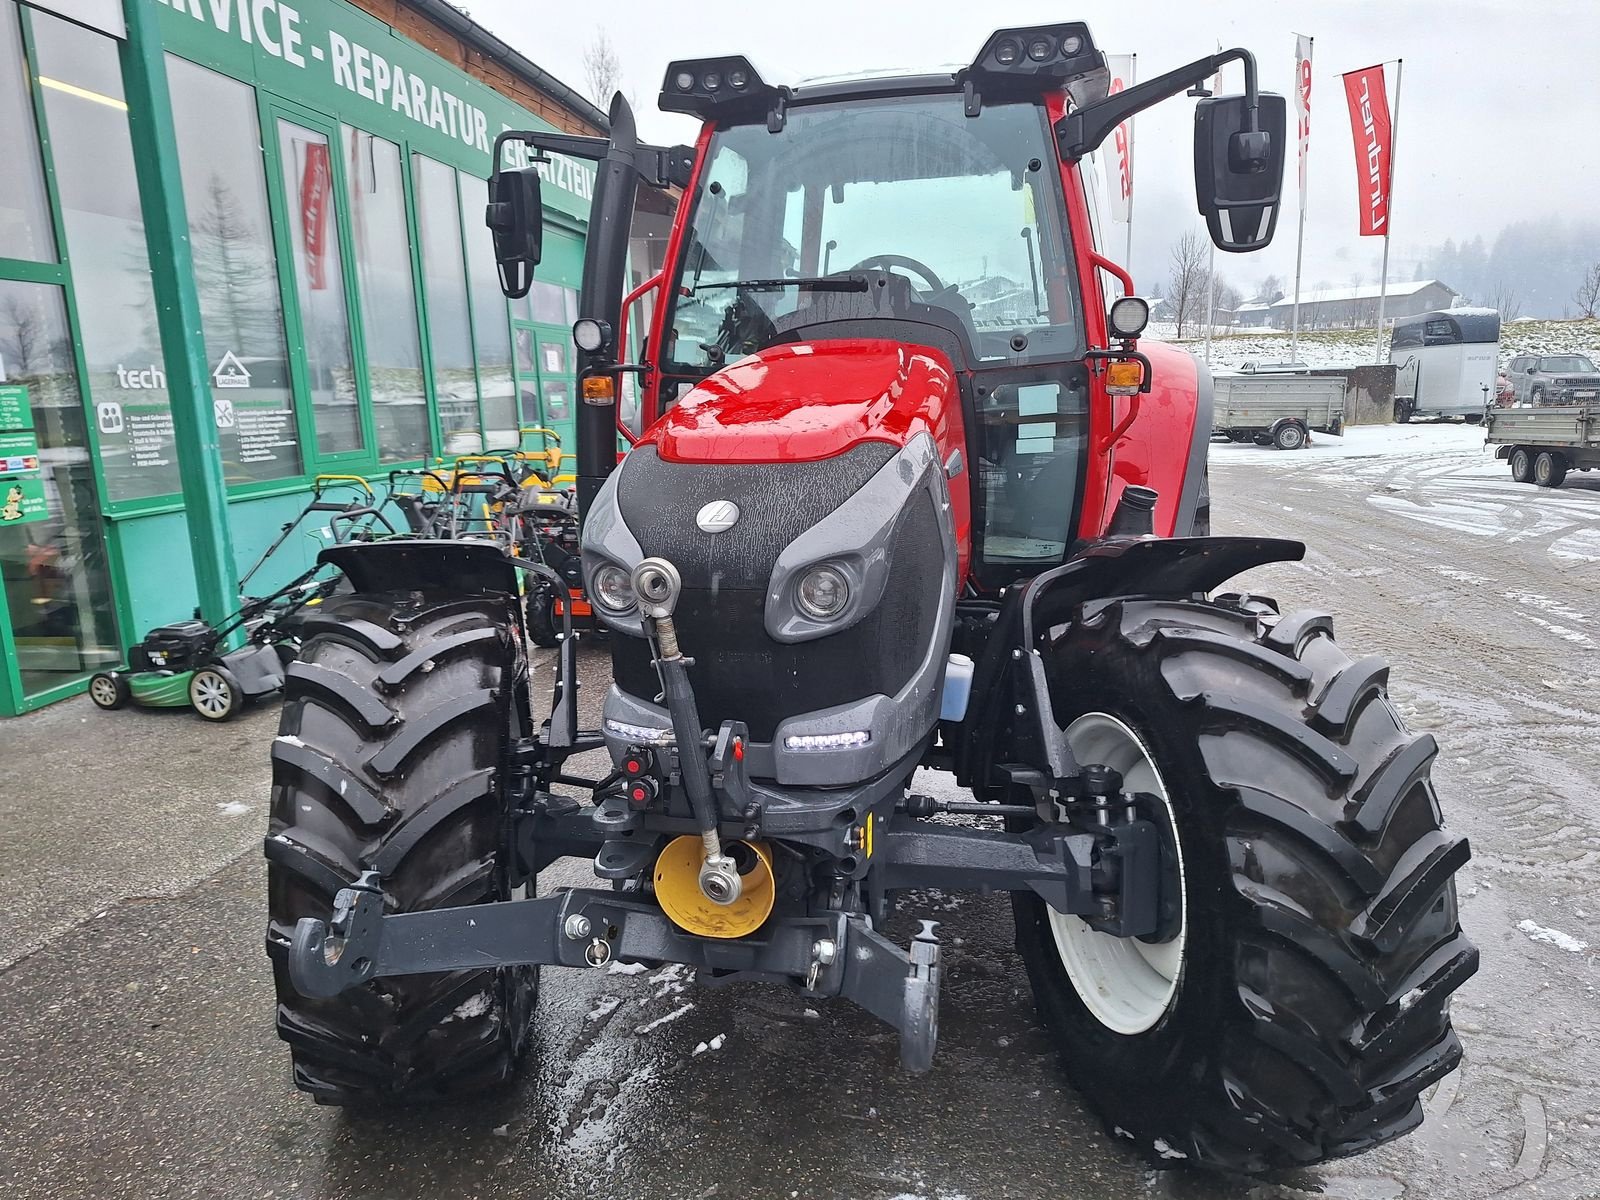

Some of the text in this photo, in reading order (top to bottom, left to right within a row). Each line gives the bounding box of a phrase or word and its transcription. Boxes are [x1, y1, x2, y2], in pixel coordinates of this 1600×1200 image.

[329, 30, 490, 154] REPARATUR
[502, 123, 597, 201] ERATZTEIL
[117, 364, 166, 389] tech
